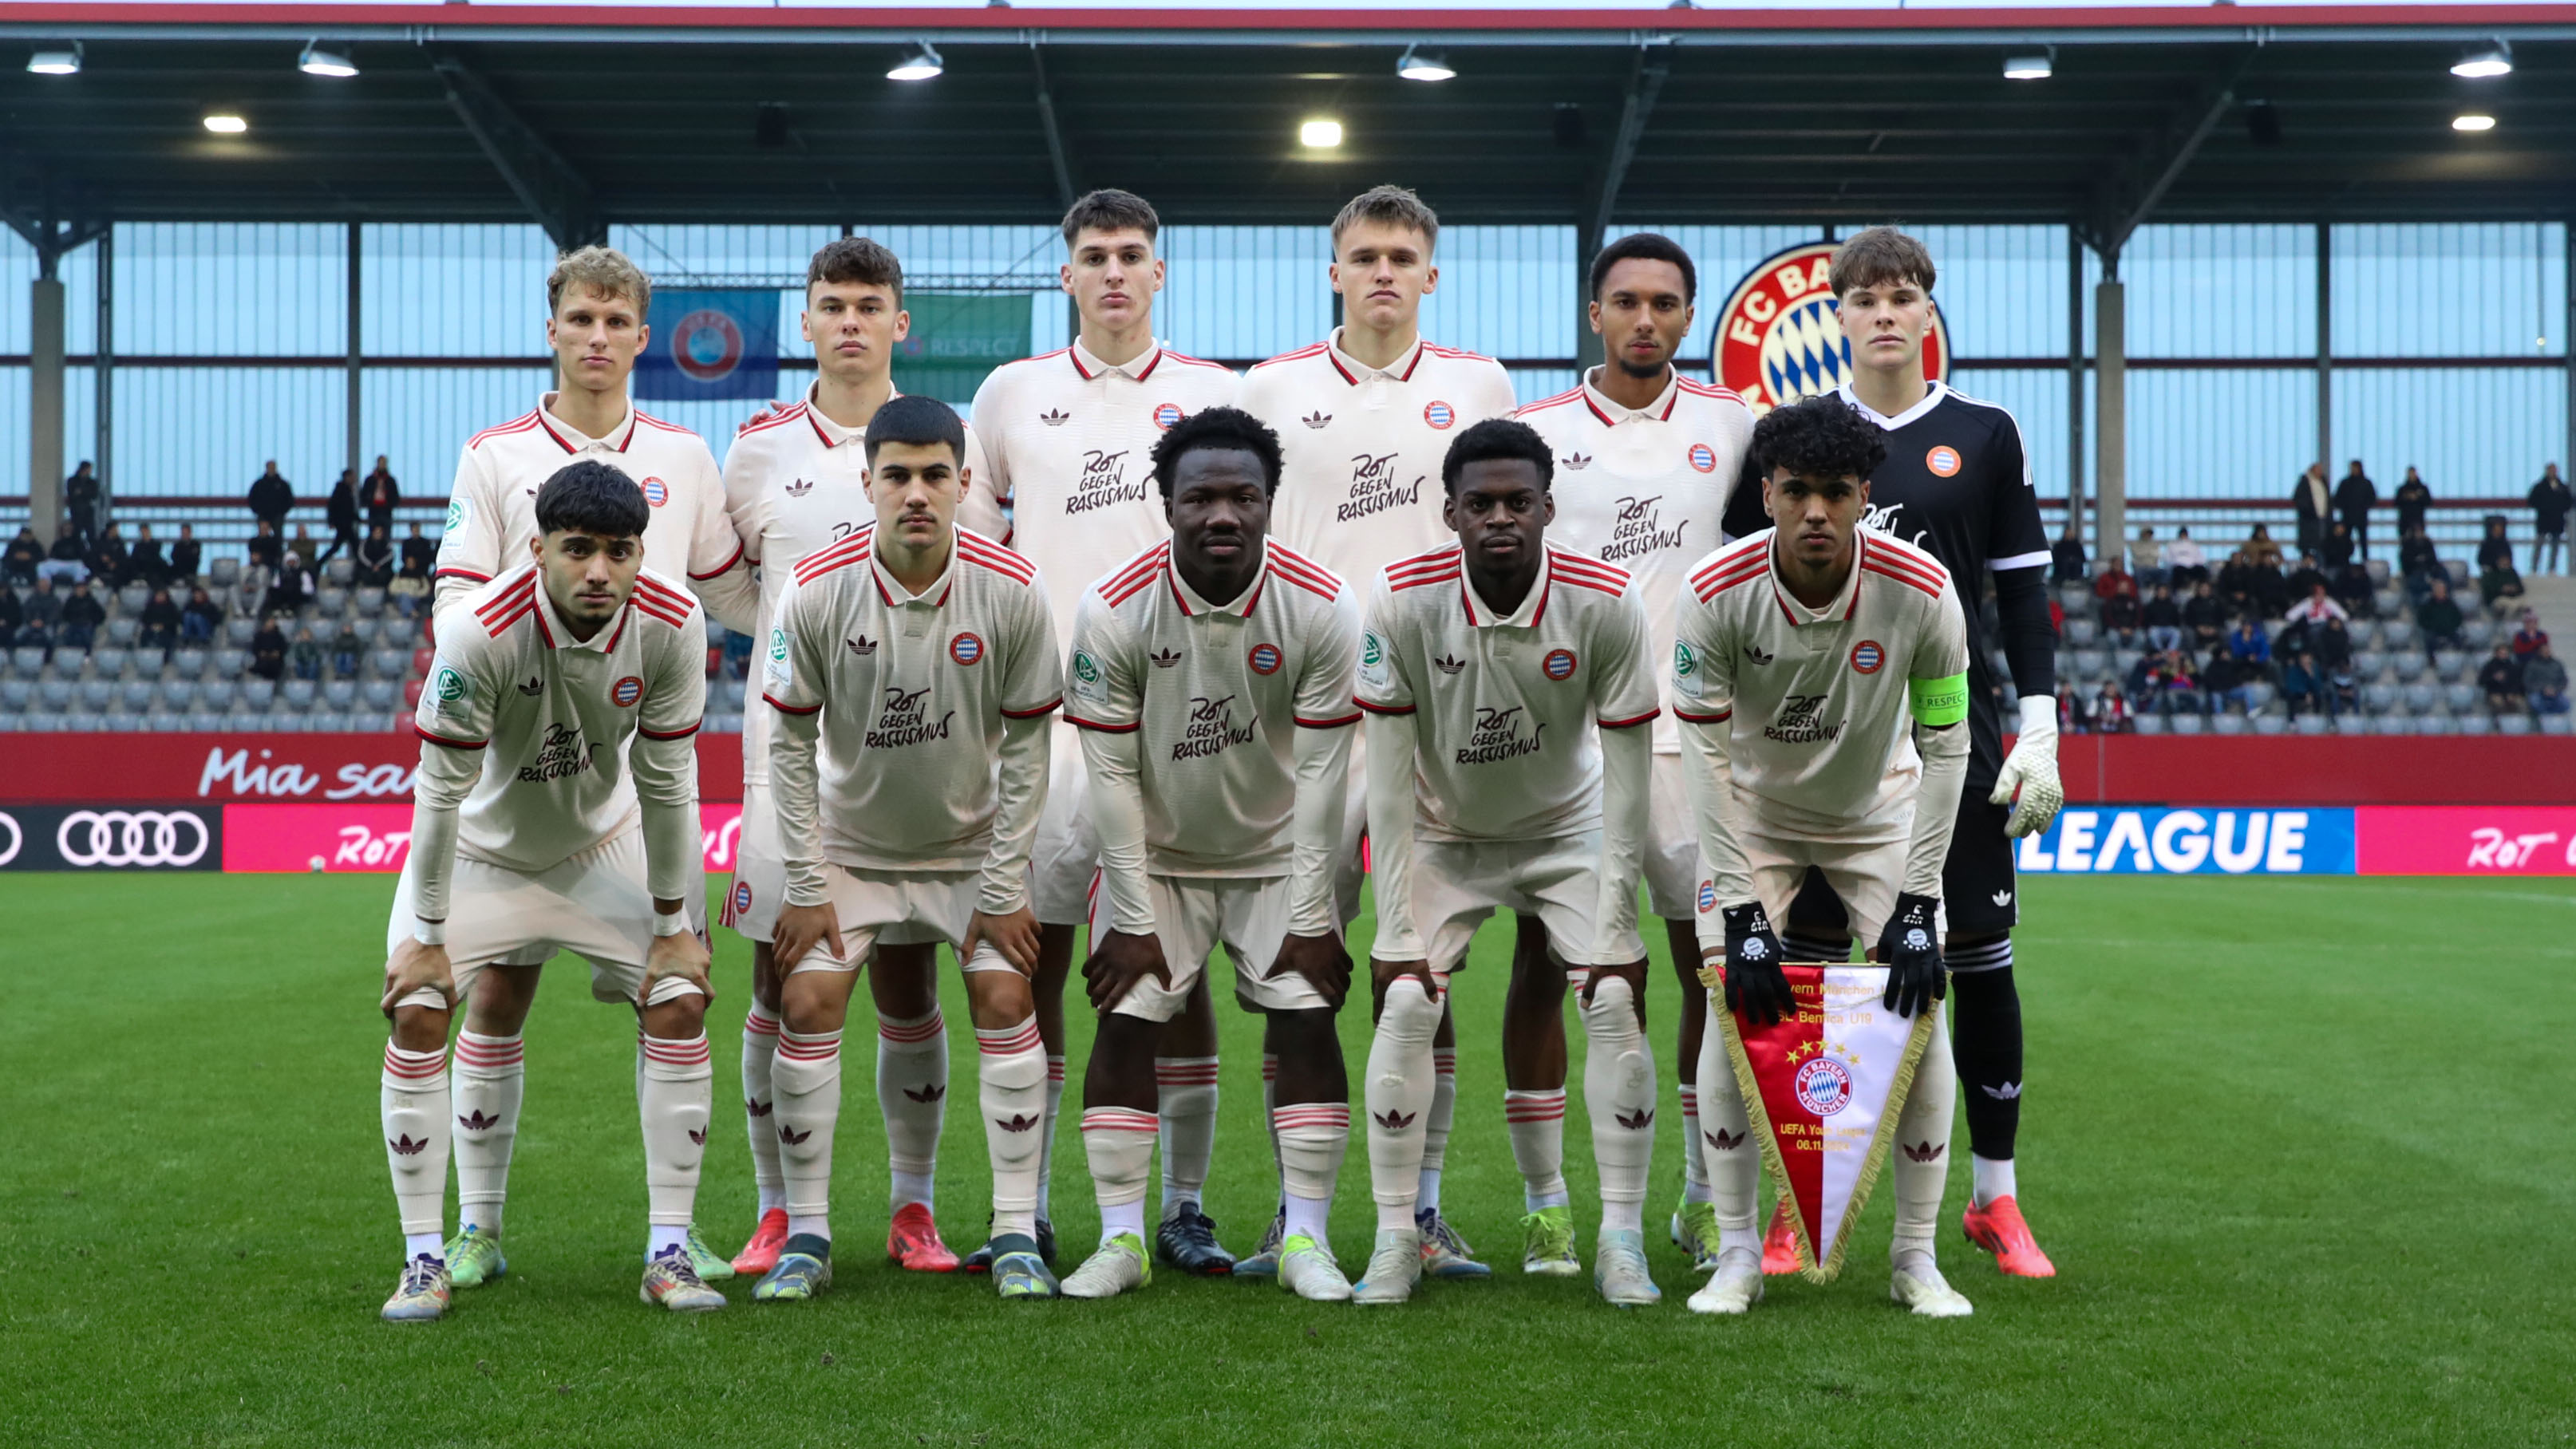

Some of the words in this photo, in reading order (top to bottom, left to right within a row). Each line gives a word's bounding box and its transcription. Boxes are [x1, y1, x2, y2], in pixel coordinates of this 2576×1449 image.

[1729, 290, 1777, 347] FC
[930, 334, 1019, 357] RESPECT
[1080, 463, 1124, 492] GEGEN
[1349, 466, 1394, 499] GEGEN
[1065, 474, 1154, 515] RASSISMUS
[1337, 476, 1426, 523] RASSISMUS
[1614, 509, 1658, 540] GEGEN
[1601, 519, 1689, 562] RASSISMUS
[865, 710, 956, 750] RASSISMUS
[879, 702, 926, 730] GEGEN
[1187, 709, 1231, 739] GEGEN
[1777, 708, 1823, 728] GEGEN
[1171, 715, 1258, 761] RASSISMUS
[1456, 723, 1547, 764] RASSISMUS
[1472, 720, 1518, 747] GEGEN
[535, 737, 583, 766] GEGEN
[198, 746, 320, 797] Mia
[324, 763, 420, 800] sa
[2017, 810, 2309, 873] LEAGUE
[1819, 982, 1875, 996] München
[1799, 1010, 1843, 1024] Benfica
[1850, 1012, 1872, 1025] U19
[1800, 1068, 1811, 1084] FC
[1811, 1061, 1848, 1084] BAYERN
[1780, 1123, 1806, 1135] UEFA
